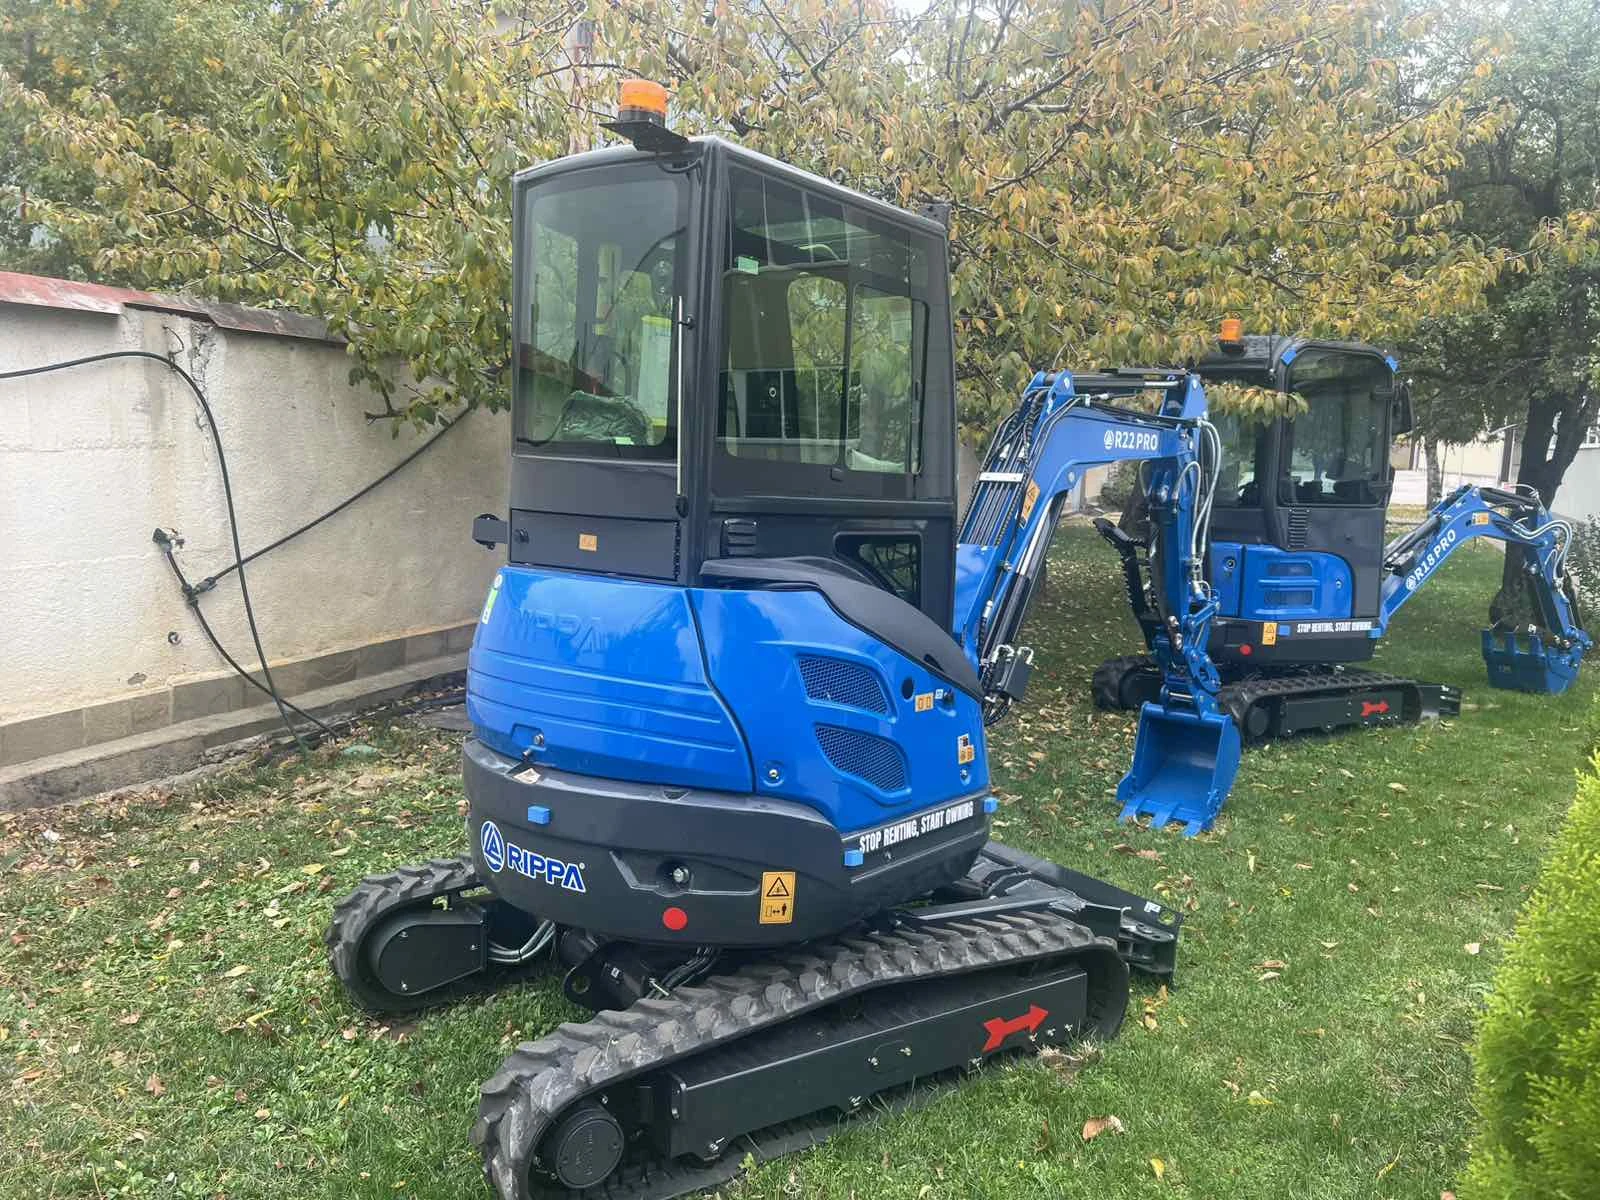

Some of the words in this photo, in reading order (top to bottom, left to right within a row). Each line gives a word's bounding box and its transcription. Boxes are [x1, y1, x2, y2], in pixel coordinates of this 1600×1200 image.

[1115, 430, 1135, 449] R22
[1135, 433, 1158, 451] PRO
[1414, 554, 1435, 581] R18
[1433, 529, 1456, 559] PRO
[859, 830, 882, 854] STOP
[883, 819, 920, 847] RENTING,
[920, 810, 945, 834] START
[945, 800, 974, 825] OWNING
[507, 842, 586, 893] RIPPA
